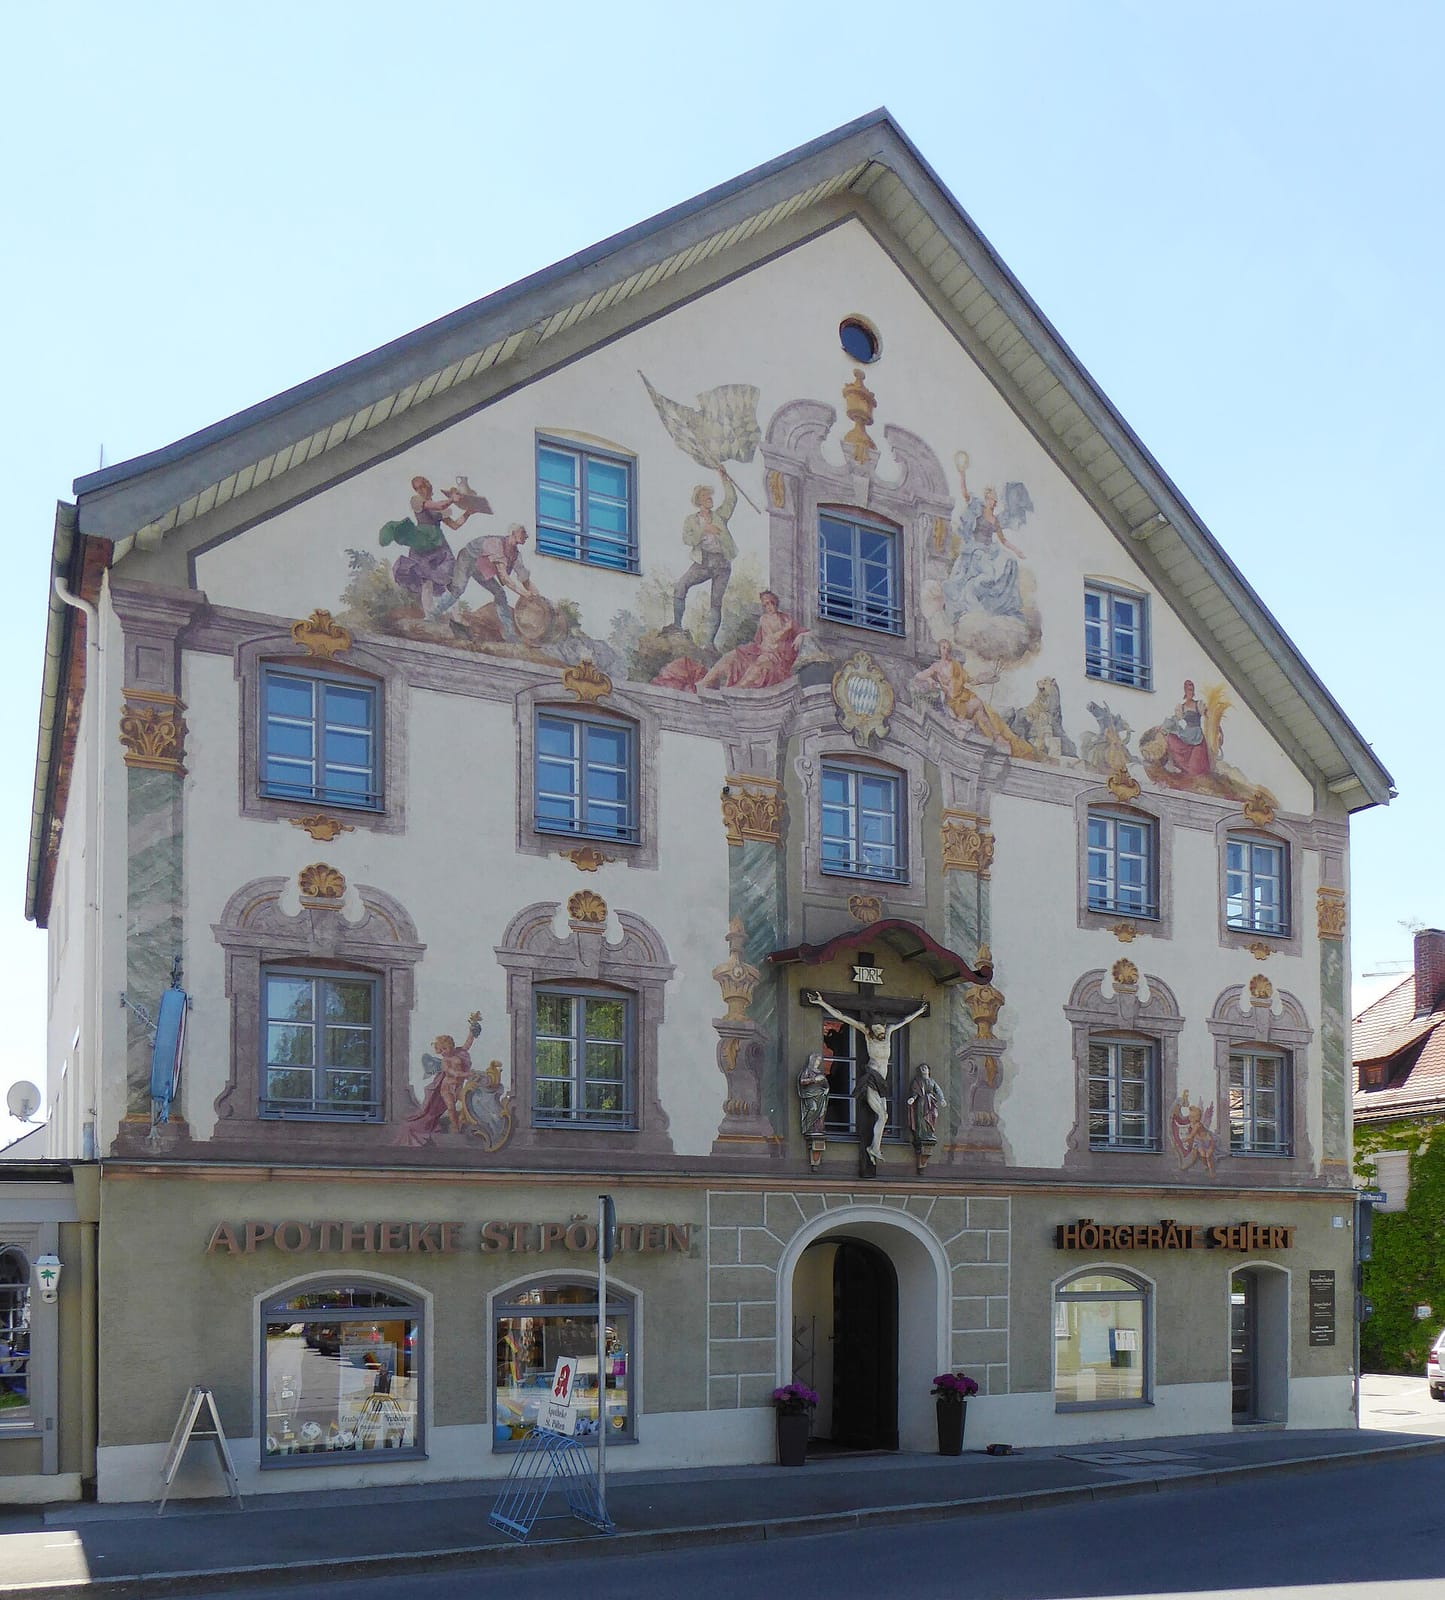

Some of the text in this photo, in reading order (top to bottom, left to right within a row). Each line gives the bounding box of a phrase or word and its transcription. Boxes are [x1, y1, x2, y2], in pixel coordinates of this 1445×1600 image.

[206, 1217, 465, 1254] APOTHEKE
[1057, 1218, 1298, 1252] HÖRGERÄTE SEIFERT
